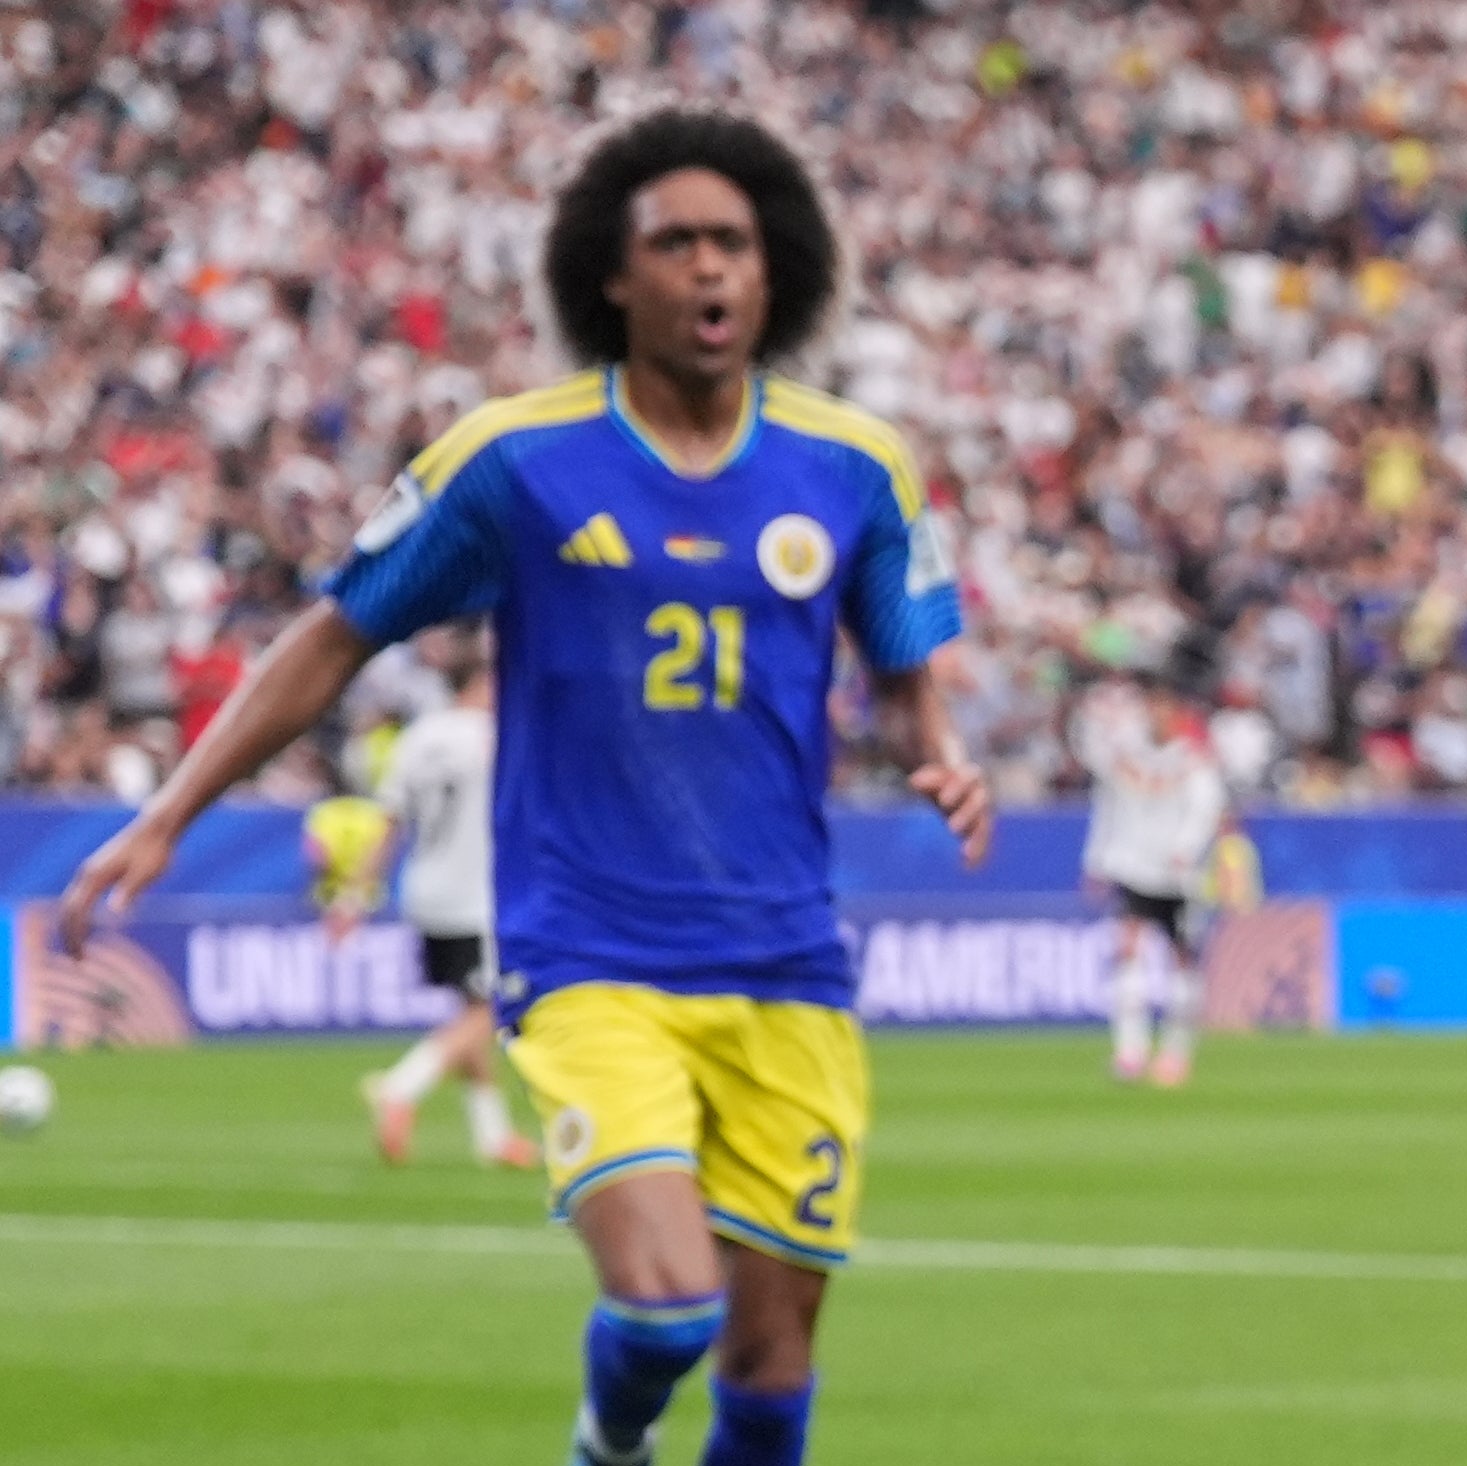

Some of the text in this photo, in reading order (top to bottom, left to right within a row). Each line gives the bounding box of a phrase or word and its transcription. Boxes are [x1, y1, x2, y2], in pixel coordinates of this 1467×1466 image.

[643, 601, 745, 711] 21
[186, 924, 462, 1029] UNITE
[796, 1137, 842, 1231] 2
